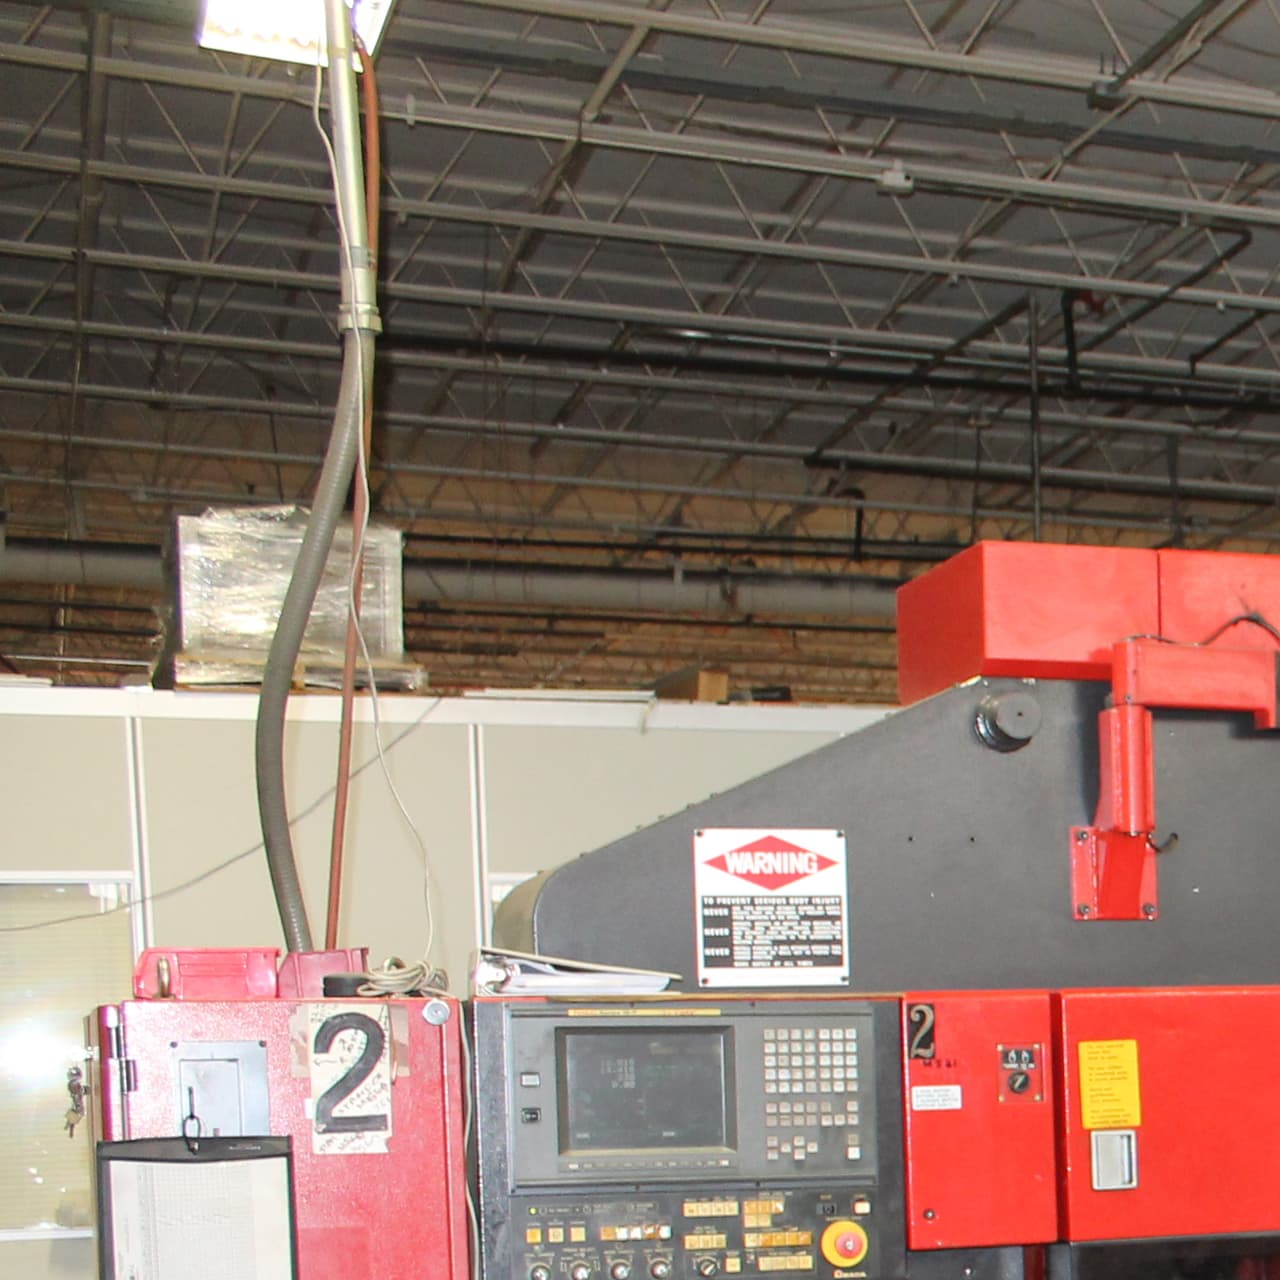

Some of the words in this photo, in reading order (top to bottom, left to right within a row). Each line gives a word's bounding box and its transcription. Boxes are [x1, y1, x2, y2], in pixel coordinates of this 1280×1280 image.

[723, 851, 819, 875] WARNING
[909, 1005, 935, 1059] 2
[313, 1012, 388, 1135] 2
